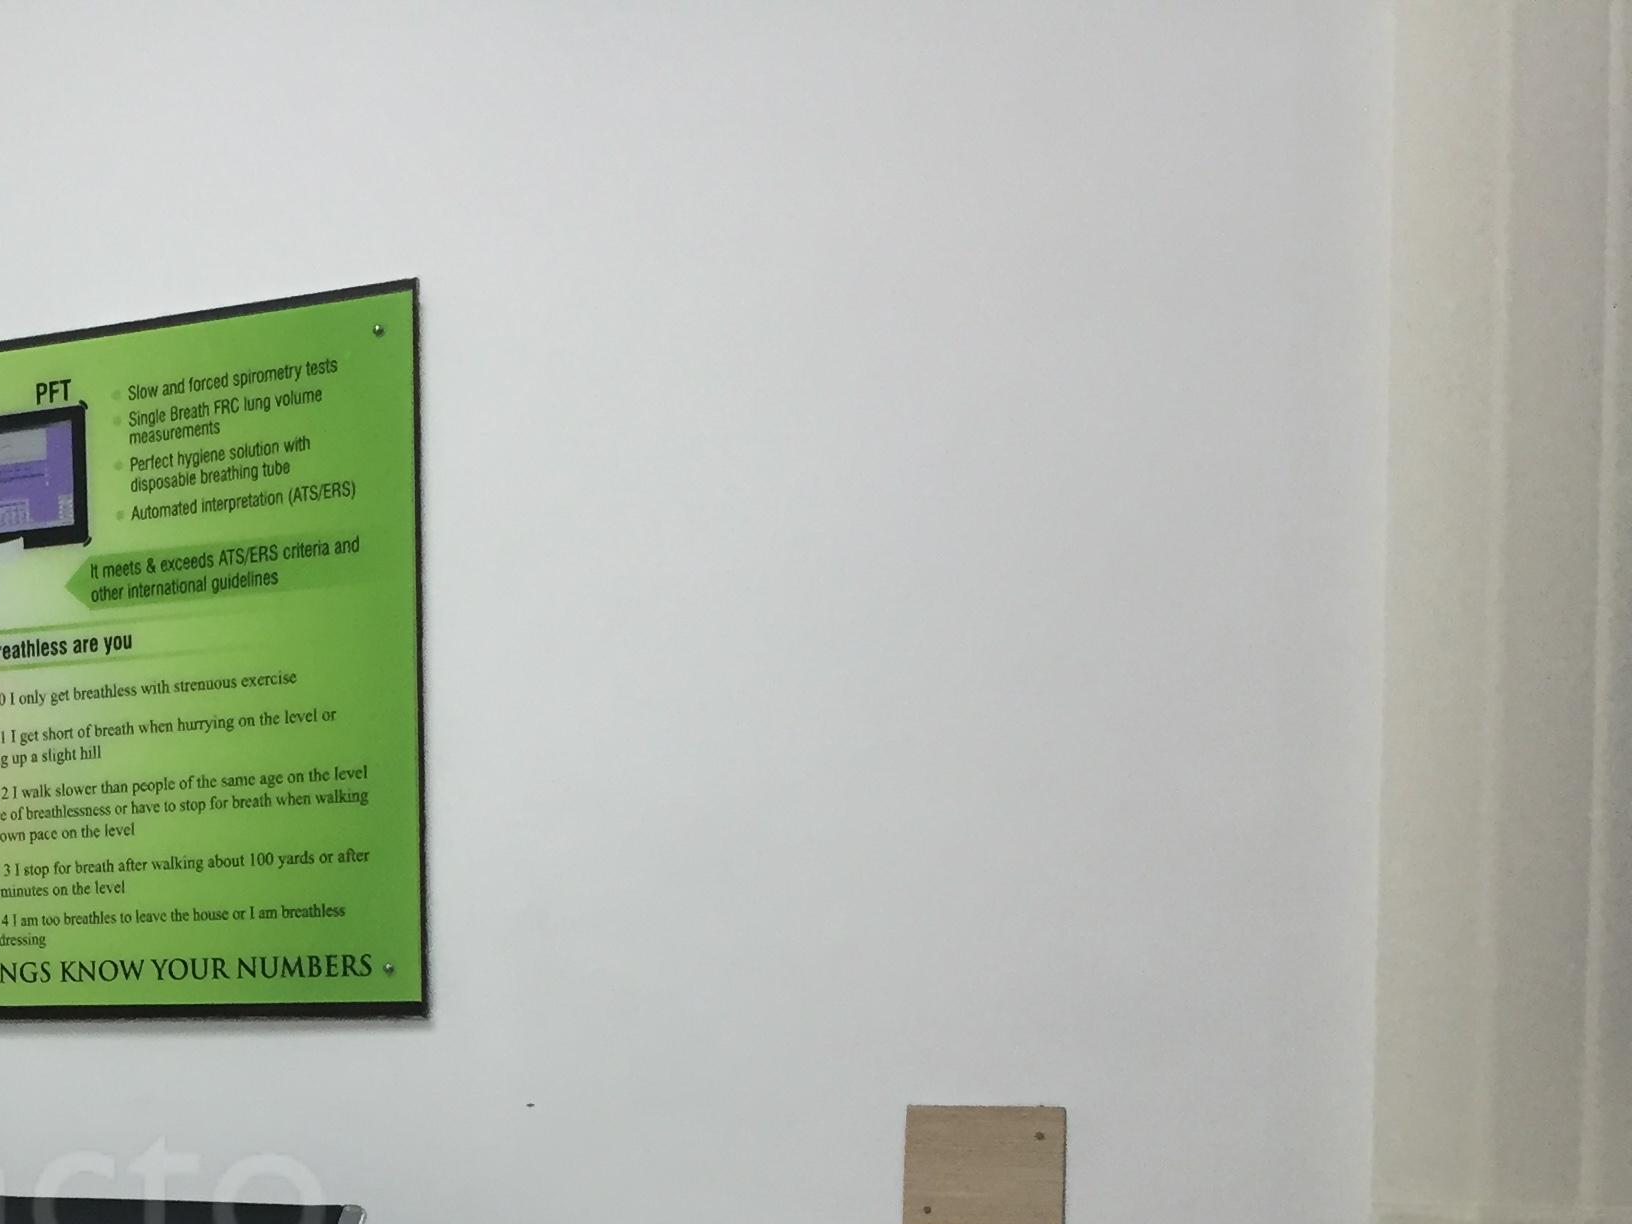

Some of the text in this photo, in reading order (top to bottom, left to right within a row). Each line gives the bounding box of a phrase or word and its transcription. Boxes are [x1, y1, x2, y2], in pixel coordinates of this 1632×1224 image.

[36, 378, 70, 404] PFT
[128, 358, 337, 400] Slow and forced spirometry tests
[128, 389, 321, 427] Single Breath FRC lung volume
[129, 421, 219, 444] measurements
[130, 435, 309, 471] Perfect hygiene solution with
[130, 460, 289, 493] disposable breathing tube
[131, 480, 355, 520] Automated interpretation (ATS/ERS)
[90, 535, 359, 578] It meets & exceeds ATS/ERS criteria and
[91, 571, 278, 602] other international guidelines
[73, 637, 97, 653] are
[103, 634, 131, 654] you
[18, 689, 45, 705] only
[50, 690, 69, 705] get
[73, 683, 136, 700] breathless
[141, 680, 169, 694] with
[174, 678, 236, 692] strenuous
[241, 673, 295, 687] exercise
[19, 730, 38, 745] get
[42, 727, 73, 740] short
[77, 723, 93, 738] of
[94, 721, 134, 737] breath
[138, 719, 172, 733] when
[177, 717, 234, 733] hurrying
[238, 716, 255, 726] on
[259, 712, 279, 725] the
[285, 708, 316, 723] level
[322, 711, 335, 721] or
[12, 754, 26, 767] up
[31, 753, 37, 762] a
[42, 747, 76, 764] slight
[80, 745, 100, 759] hill
[1, 786, 8, 799] 2
[21, 784, 50, 798] walk
[55, 783, 97, 796] slower
[101, 780, 127, 793] than
[132, 777, 174, 796] people
[179, 775, 194, 789] of
[196, 774, 216, 788] the
[221, 776, 255, 787] same
[259, 774, 282, 788] age
[287, 772, 303, 783] on
[309, 768, 329, 781] the
[334, 765, 366, 780] level
[0, 831, 25, 842] own
[29, 830, 57, 844] pace
[61, 829, 76, 838] on
[81, 824, 100, 838] the
[105, 822, 134, 836] level
[4, 863, 10, 876] 3
[23, 864, 49, 878] stop
[53, 861, 71, 874] for
[75, 859, 113, 873] breath
[118, 858, 147, 871] after
[151, 856, 203, 872] walking
[207, 854, 244, 867] about
[250, 852, 273, 865] 100
[278, 850, 314, 868] yards
[319, 853, 332, 863] or
[338, 848, 369, 862] after
[0, 886, 48, 897] minutes
[52, 886, 68, 895] on
[72, 881, 90, 894] the
[94, 880, 124, 893] level
[60, 959, 143, 981] KNOW
[150, 957, 229, 979] YOUR
[237, 954, 371, 978] NUMBERS
